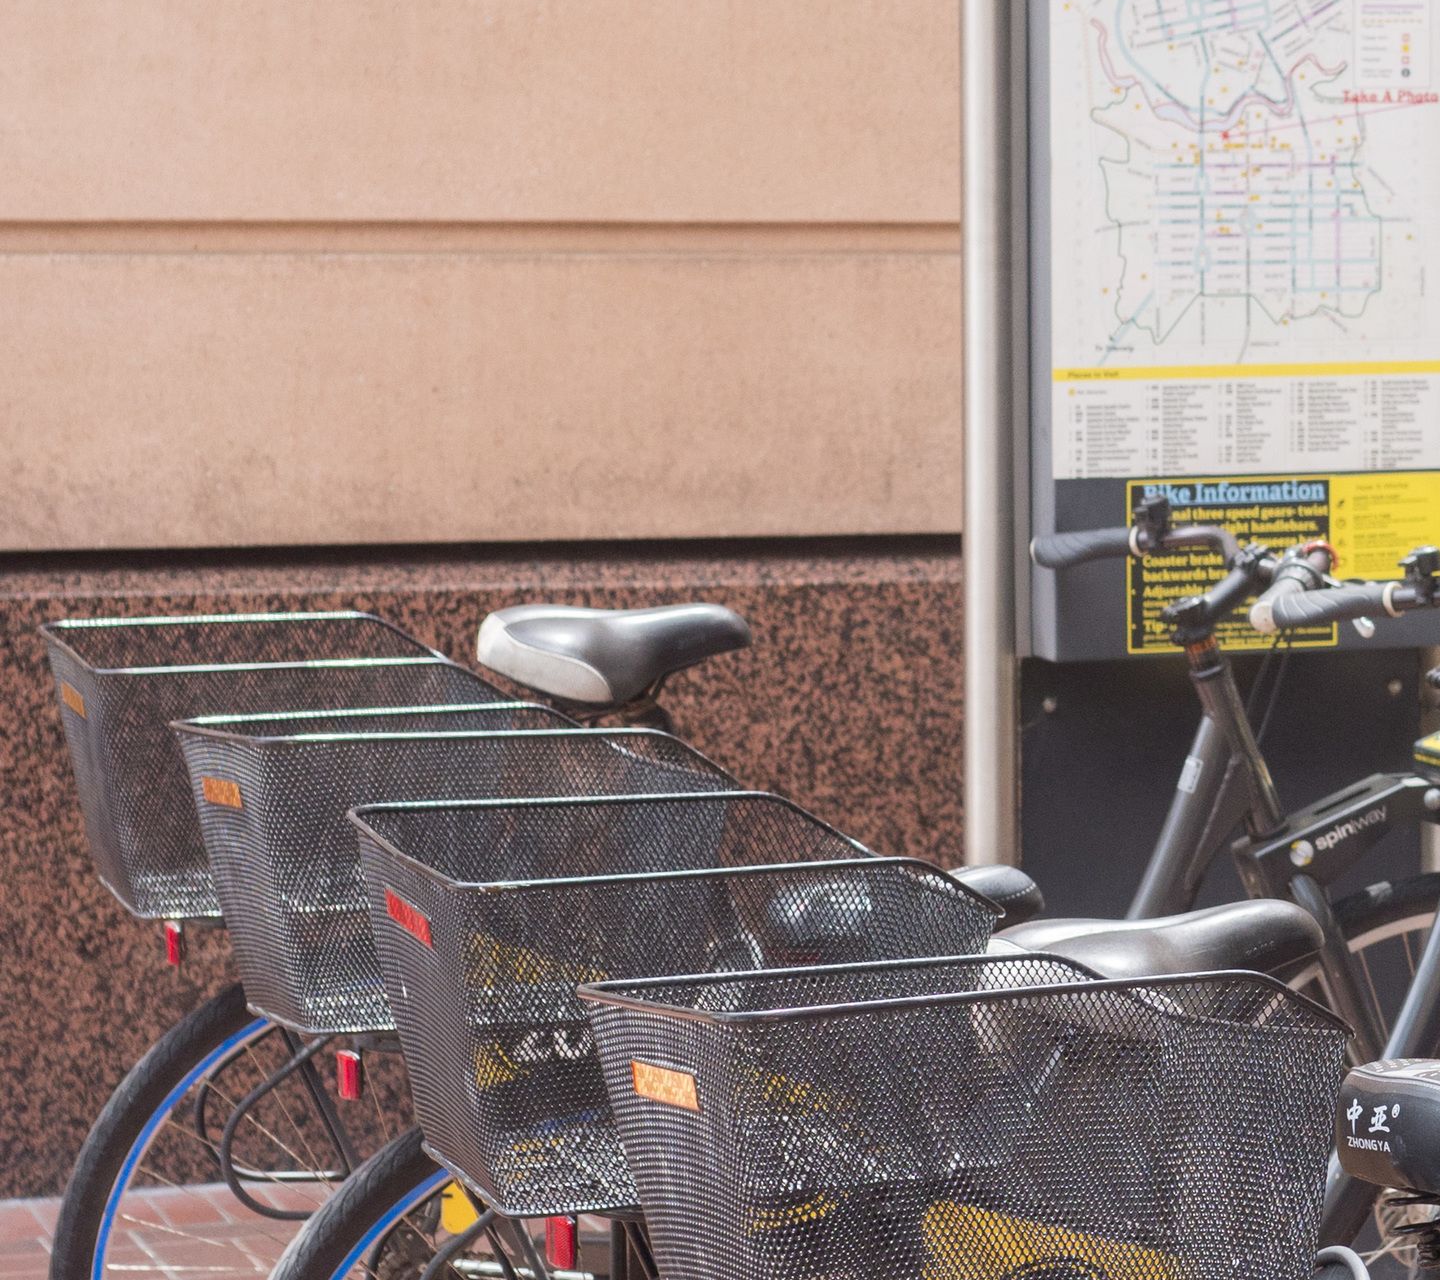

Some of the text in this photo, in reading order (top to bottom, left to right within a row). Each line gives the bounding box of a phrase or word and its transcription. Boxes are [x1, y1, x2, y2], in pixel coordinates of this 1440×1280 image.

[1383, 91, 1392, 103] A
[1398, 91, 1439, 104] Photo
[1196, 479, 1326, 503] Information
[1227, 506, 1259, 521] speed
[1143, 555, 1187, 567] Coaster
[1143, 569, 1206, 582] backwards
[1347, 1136, 1391, 1153] ZHONGYA
